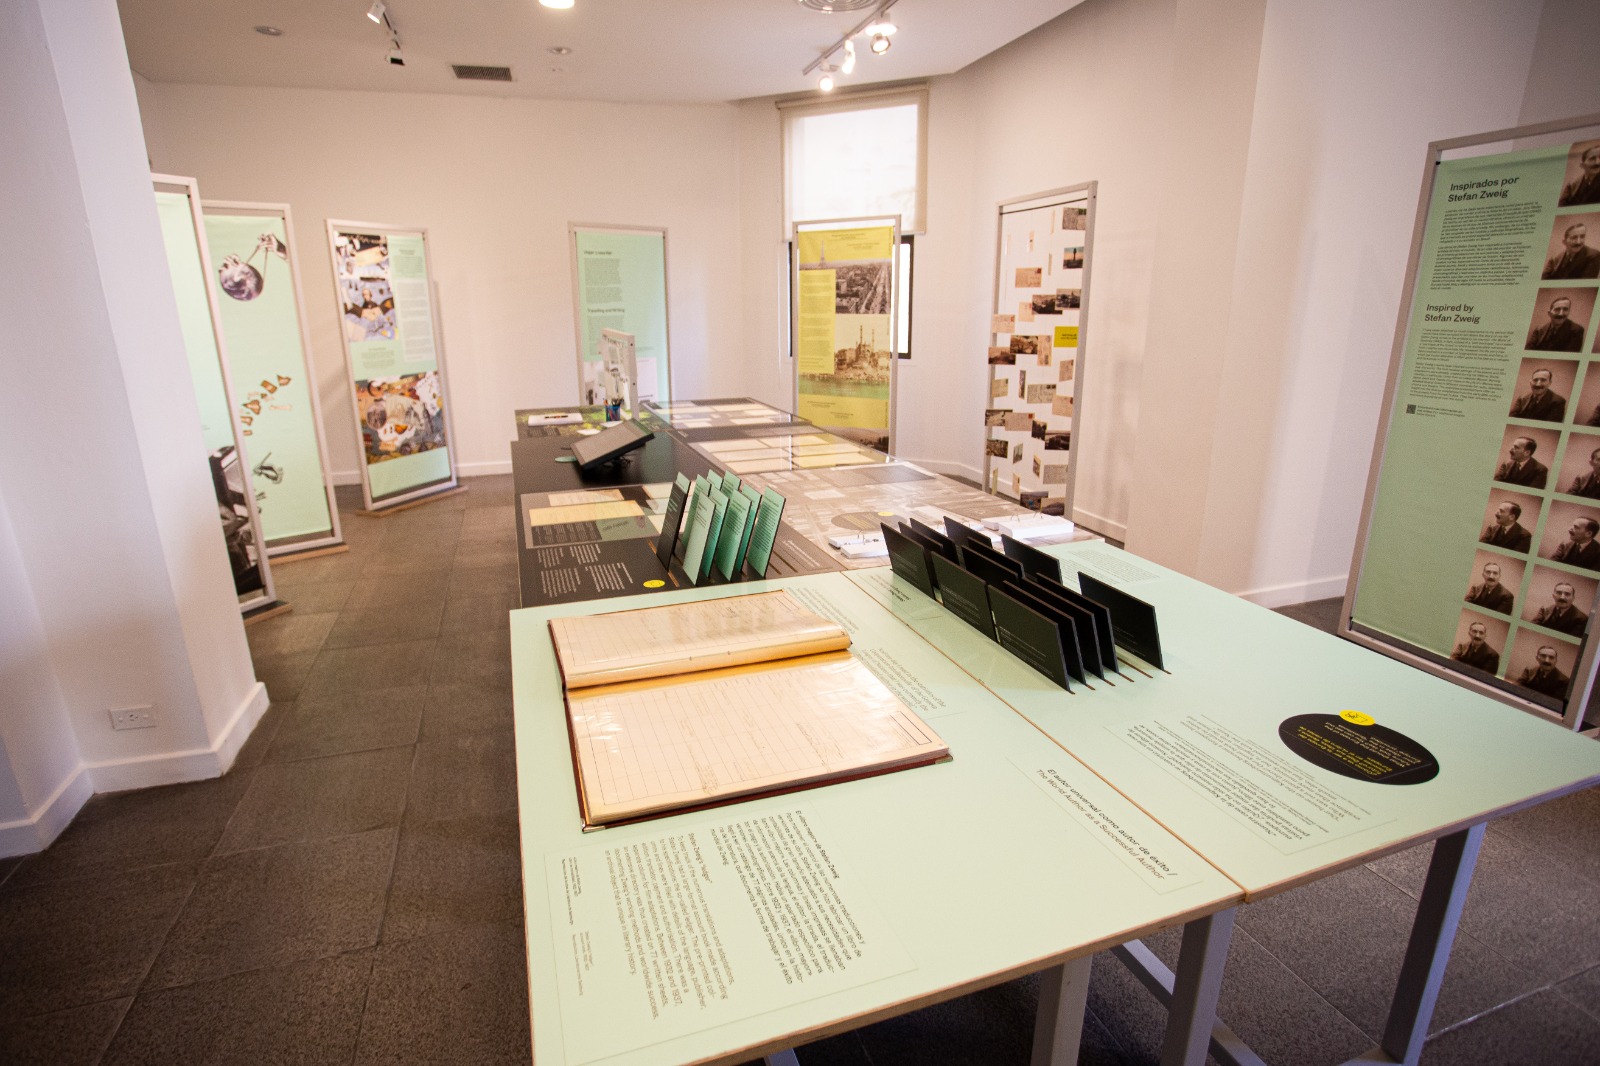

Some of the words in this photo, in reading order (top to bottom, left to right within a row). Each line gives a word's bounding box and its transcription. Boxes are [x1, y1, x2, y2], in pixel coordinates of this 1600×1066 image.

[1448, 190, 1477, 202] Stefan
[1480, 188, 1509, 200] Zweig
[1450, 178, 1498, 192] Inspirados
[1501, 176, 1520, 188] por
[1424, 314, 1452, 322] Stefan
[1454, 314, 1480, 324] Zweig
[1426, 304, 1461, 313] Inspired
[1464, 304, 1474, 314] by
[1036, 769, 1047, 779] The
[1047, 778, 1066, 794] World
[1064, 794, 1086, 811] Author
[1099, 824, 1138, 856] Successful
[1136, 857, 1164, 878] Author
[1053, 774, 1071, 787] autor
[1070, 788, 1101, 812] universal
[1098, 812, 1119, 828] como
[1118, 829, 1139, 845] autor
[1138, 846, 1150, 854] de
[1149, 856, 1169, 871] éxito
[688, 832, 696, 846] Stefan
[819, 849, 830, 864] Stefan
[828, 864, 839, 878] Zweig
[754, 886, 767, 905] páginas
[763, 882, 774, 896] Entre
[771, 896, 781, 909] 1932
[800, 856, 812, 871] Stefan
[809, 871, 820, 886] Zweig
[822, 892, 830, 904] hizo
[828, 904, 844, 925] fabricar
[846, 934, 856, 948] libro
[631, 918, 641, 943] methods
[672, 850, 681, 864] Zweig
[693, 910, 705, 932] account
[701, 933, 710, 947] book
[707, 948, 716, 965] made
[712, 967, 728, 999] according
[702, 903, 716, 934] translations
[712, 935, 722, 947] and
[787, 868, 802, 891] columnas
[810, 911, 827, 936] impresas
[829, 944, 845, 970] llenaban
[801, 875, 817, 899] adecuado
[817, 904, 825, 913] sus
[823, 914, 844, 948] necesidades
[842, 948, 851, 960] que
[840, 904, 862, 939] traducciones
[636, 944, 645, 955] and
[656, 932, 667, 958] Between
[640, 956, 652, 988] worldwide
[664, 959, 673, 974] 1932
[693, 948, 712, 983] pre-printed
[667, 975, 677, 988] and
